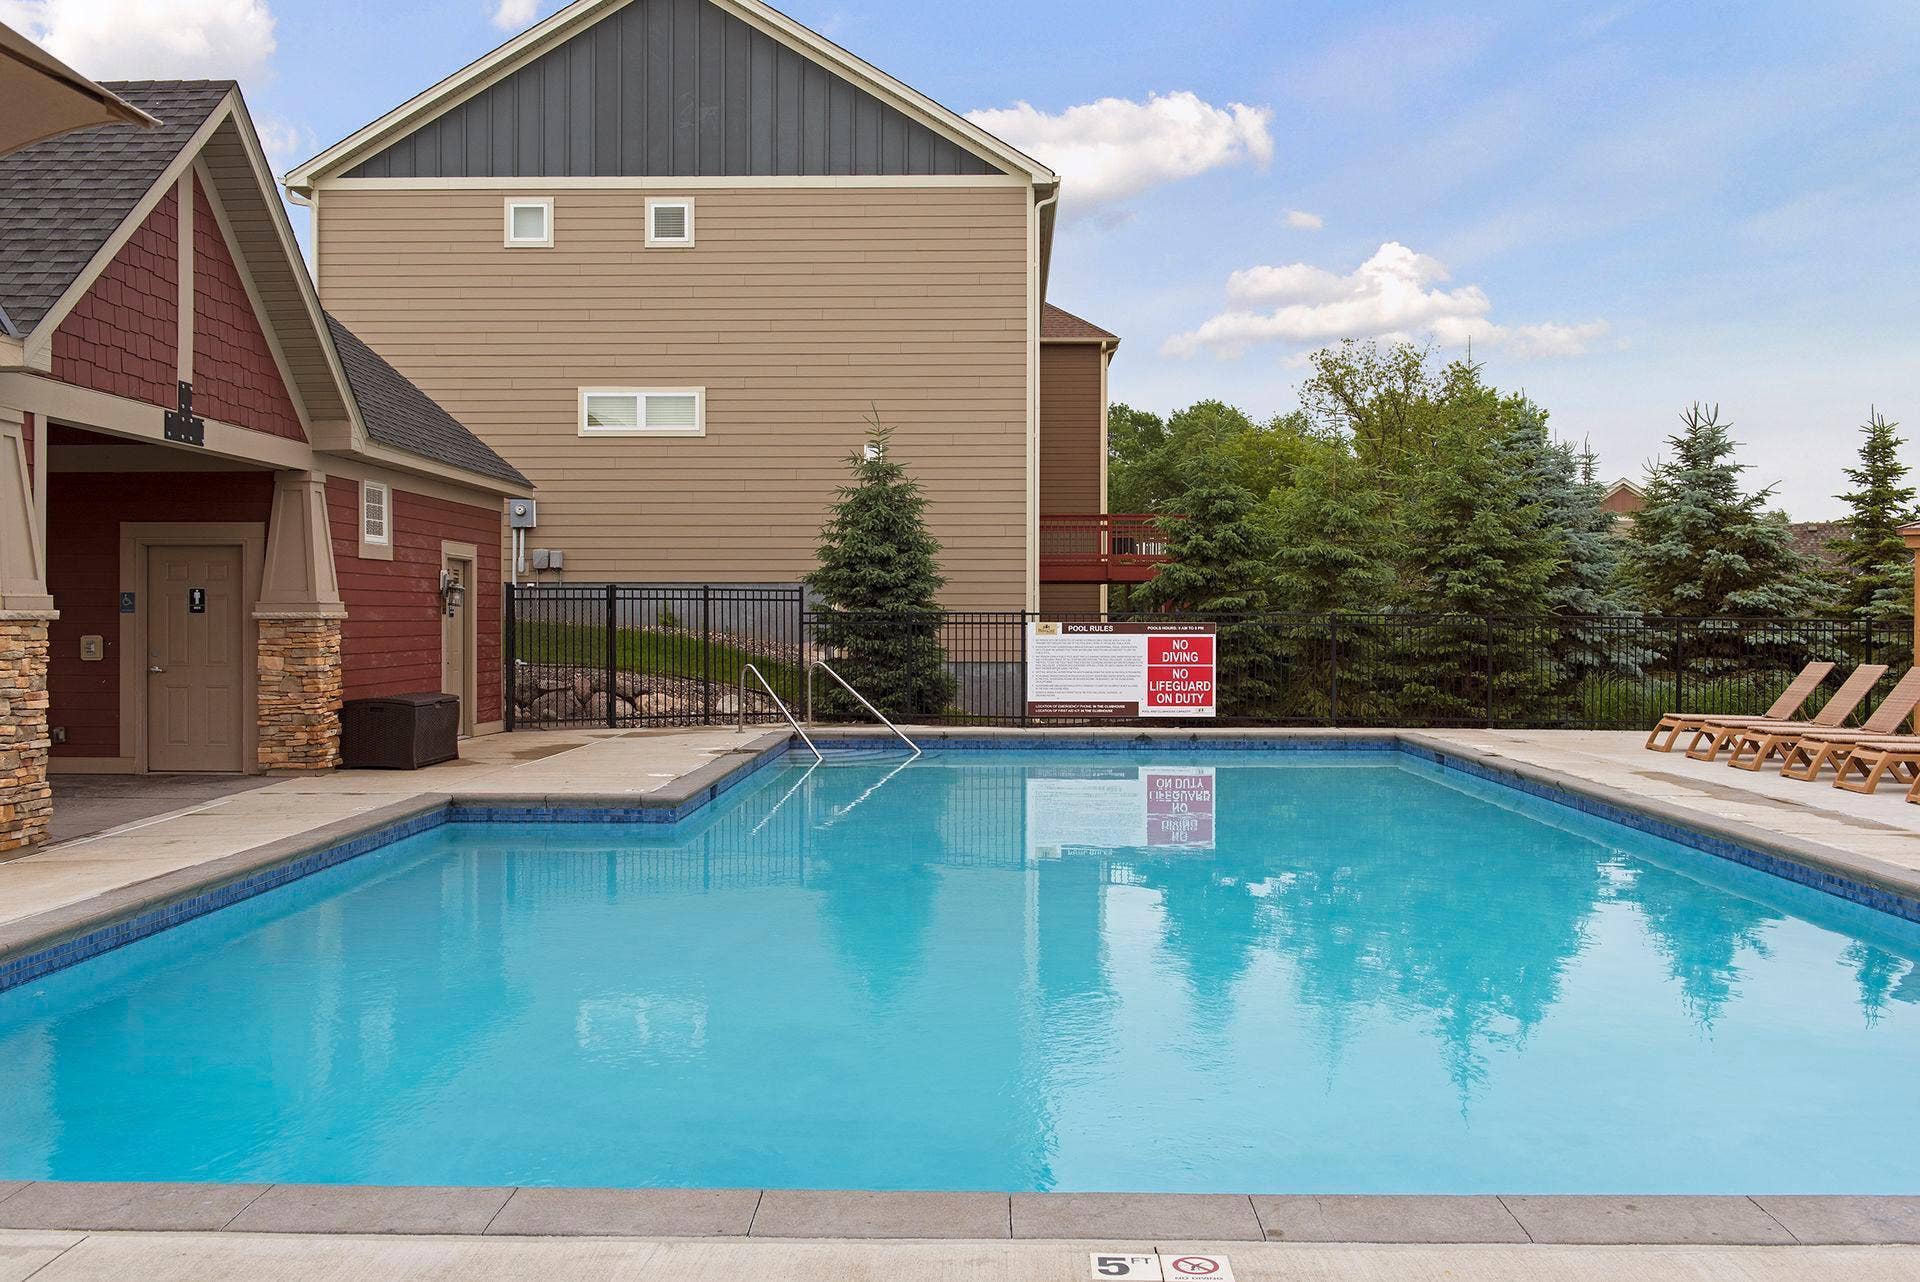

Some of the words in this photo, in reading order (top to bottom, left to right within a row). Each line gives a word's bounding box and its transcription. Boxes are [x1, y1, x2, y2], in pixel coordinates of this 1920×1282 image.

[1172, 639, 1188, 650] NO
[1162, 652, 1198, 662] DIVING
[1172, 669, 1188, 679] NO
[1149, 681, 1211, 691] LIFEGUARD
[1156, 693, 1172, 703] ON
[1175, 693, 1204, 703] DUTY
[1097, 1256, 1130, 1276] 5
